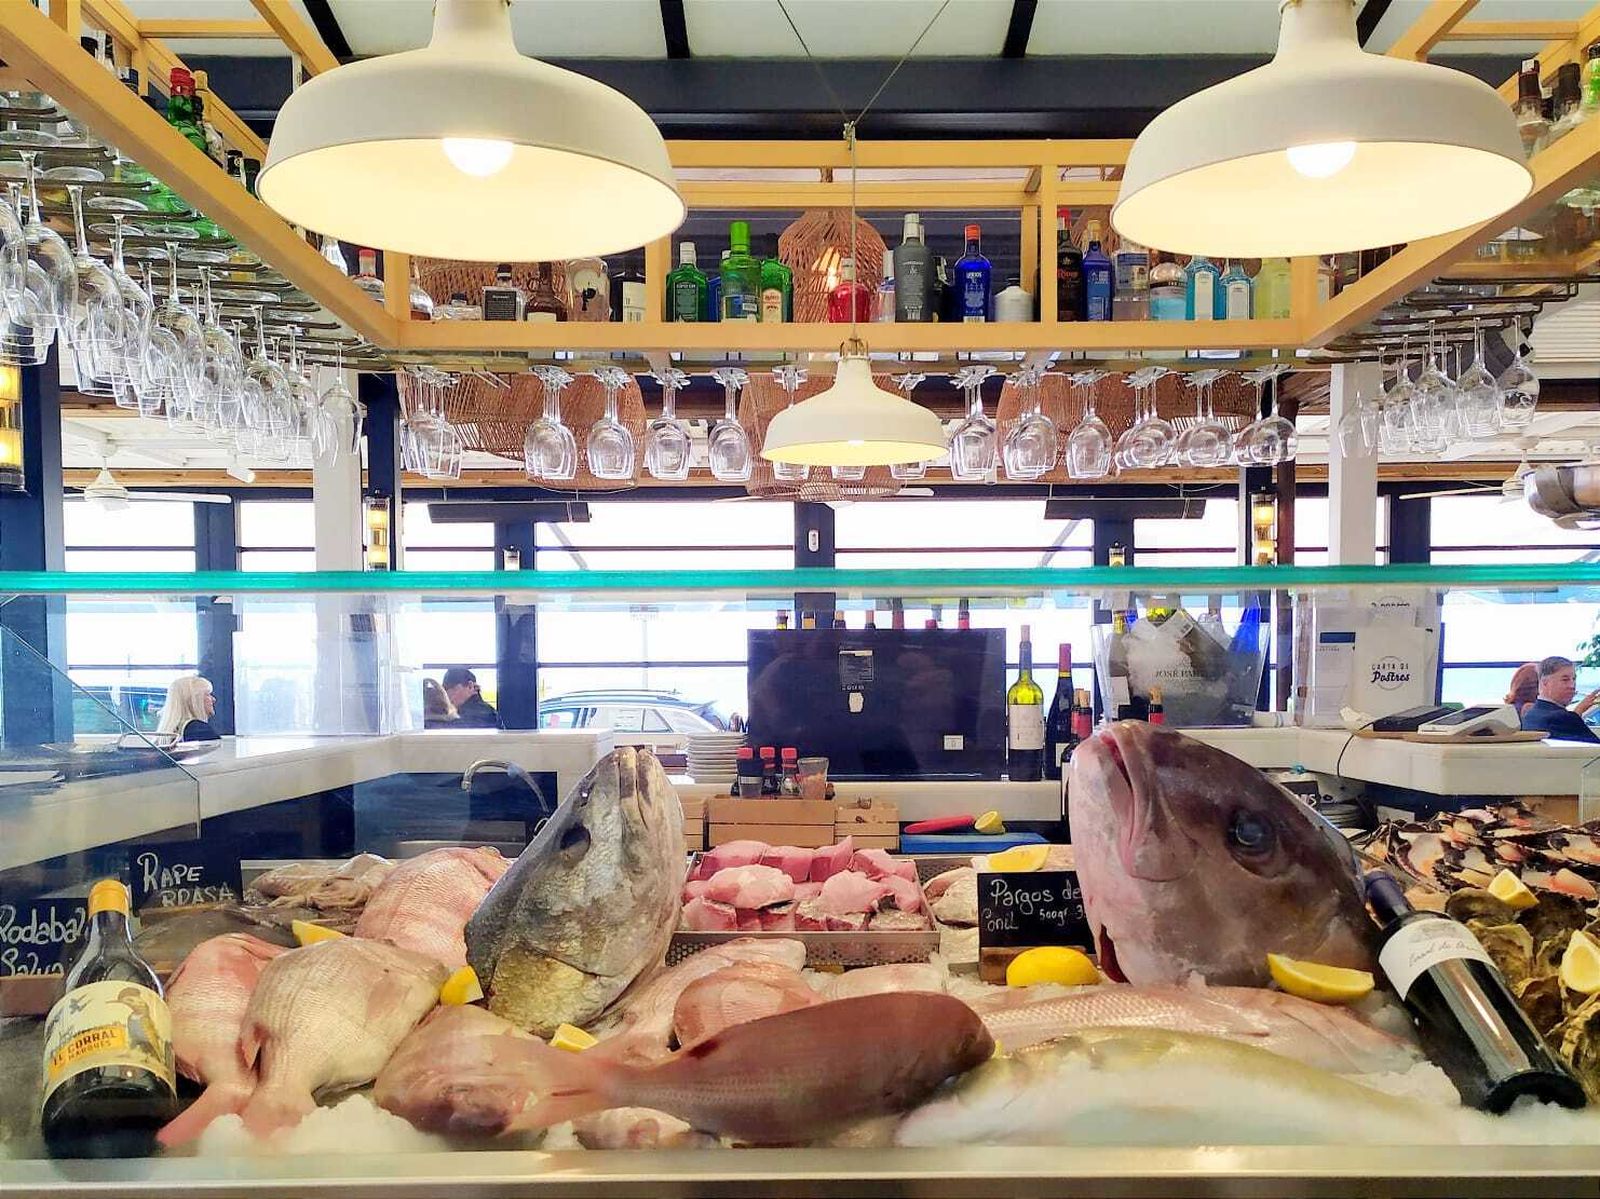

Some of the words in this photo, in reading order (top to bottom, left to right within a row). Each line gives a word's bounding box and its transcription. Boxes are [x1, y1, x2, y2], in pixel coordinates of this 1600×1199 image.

[1371, 671, 1410, 683] Postres
[137, 852, 204, 893] RAPE
[990, 879, 1054, 915] Pargos
[1062, 879, 1083, 900] de
[67, 1028, 119, 1054] CORRAL
